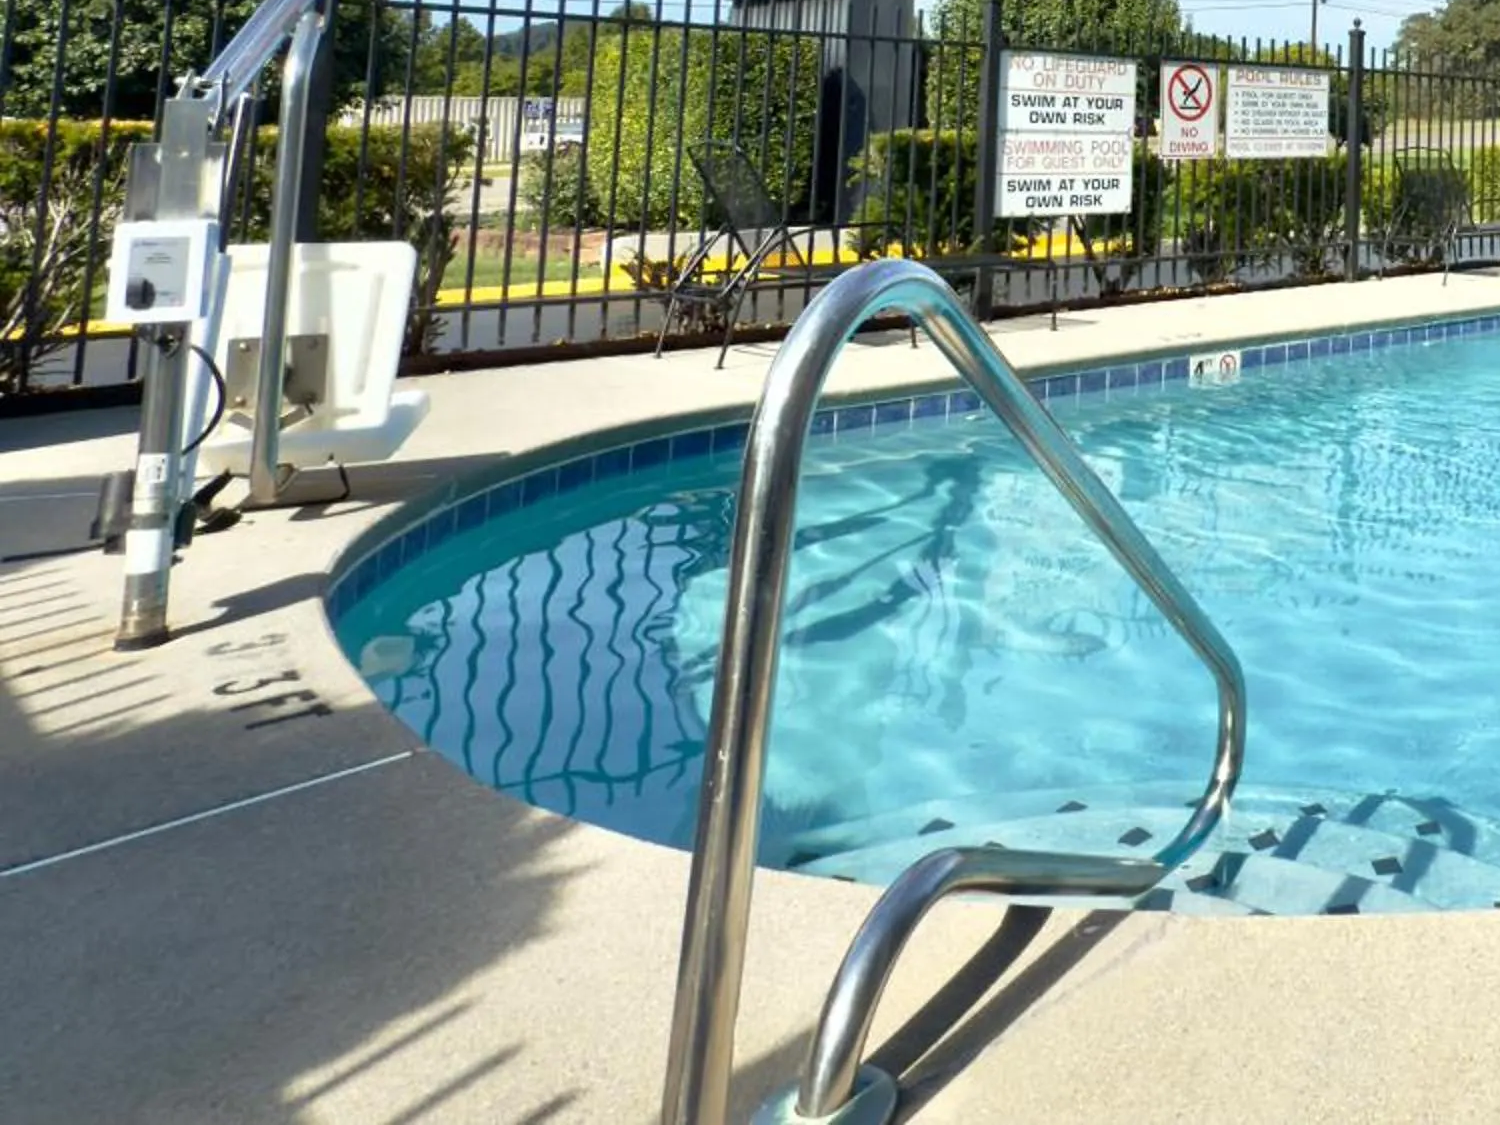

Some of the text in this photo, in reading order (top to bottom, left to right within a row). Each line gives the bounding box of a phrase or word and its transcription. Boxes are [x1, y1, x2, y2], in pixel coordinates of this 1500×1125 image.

[1010, 56, 1128, 76] NO LIFEGUARD
[1033, 72, 1106, 90] ON DUTY
[1235, 68, 1322, 86] POOL RULES
[1011, 94, 1123, 110] SWIM AT YOUR
[1029, 111, 1105, 125] OWN RISK
[1181, 126, 1199, 138] NO
[1003, 139, 1128, 156] SWIMMING POOL
[1169, 141, 1209, 153] DIVING
[1007, 156, 1125, 170] FOR GUEST ONLY
[1007, 178, 1121, 192] SWIM AT YOUR
[1025, 195, 1103, 208] OWN RISK
